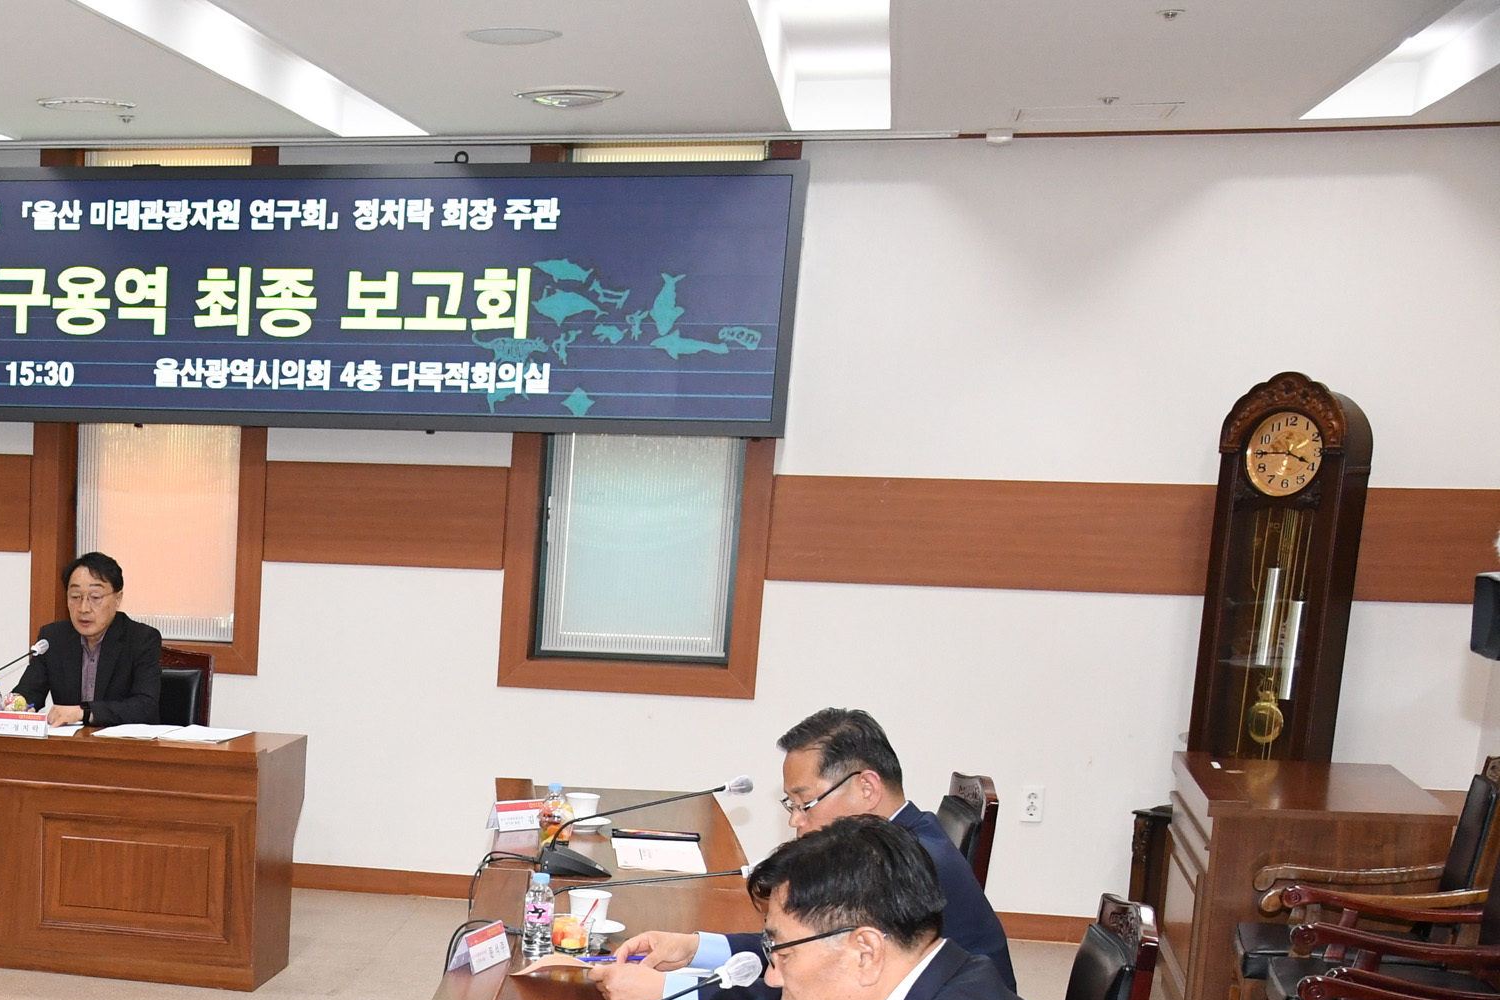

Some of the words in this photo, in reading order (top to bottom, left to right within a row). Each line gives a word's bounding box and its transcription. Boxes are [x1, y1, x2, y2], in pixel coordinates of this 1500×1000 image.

[90, 199, 241, 231] 미래관광자원
[352, 198, 435, 231] 정치락
[441, 197, 497, 231] 회장
[503, 197, 561, 230] 주관
[193, 266, 318, 338] 최종
[340, 267, 532, 340] 보고회
[5, 360, 75, 387] 15:30
[153, 357, 331, 391] 울산광역시의회
[339, 359, 383, 392] 4층
[390, 360, 551, 394] 다목적회의실
[1285, 415, 1298, 427] 12
[1305, 421, 1310, 430] 1
[1271, 422, 1282, 432] 11
[1260, 434, 1271, 444] 10
[1312, 432, 1321, 442] 2
[1314, 447, 1323, 457] 3
[1257, 463, 1267, 473] 8
[1307, 462, 1316, 472] 4
[1267, 474, 1275, 484] 7
[1281, 479, 1289, 488] 6
[1296, 474, 1306, 484] 5
